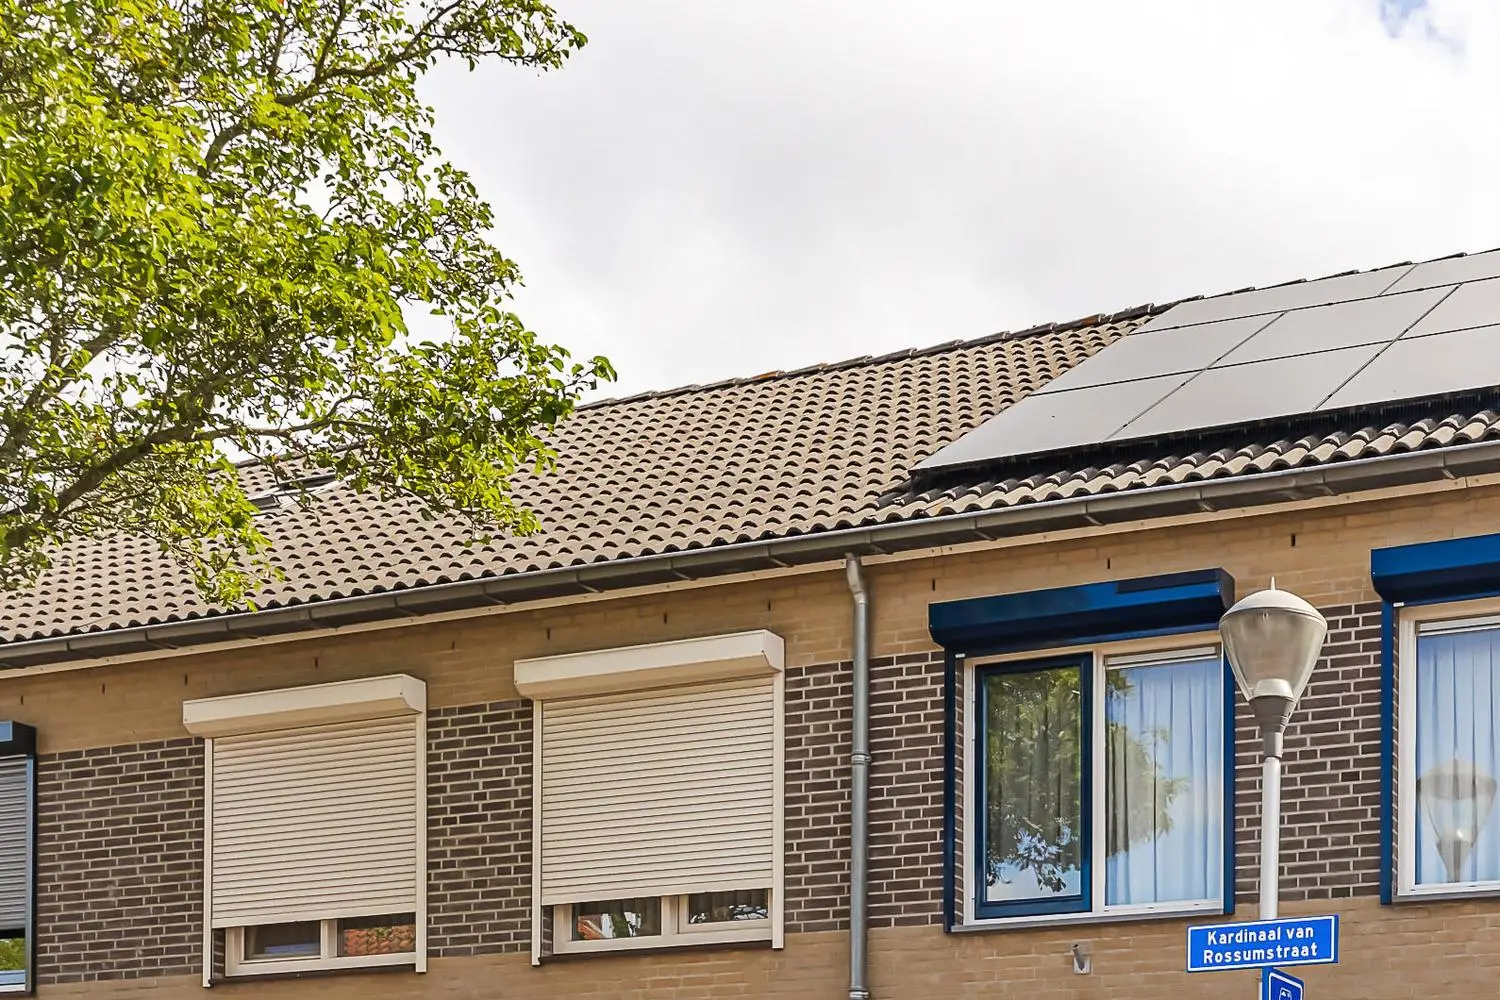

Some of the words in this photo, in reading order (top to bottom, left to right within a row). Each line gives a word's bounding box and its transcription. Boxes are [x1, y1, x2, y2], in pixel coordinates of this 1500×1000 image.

[1207, 926, 1281, 946] Kardinaal
[1286, 926, 1314, 939] van
[1203, 942, 1318, 964] Rossumstraat
